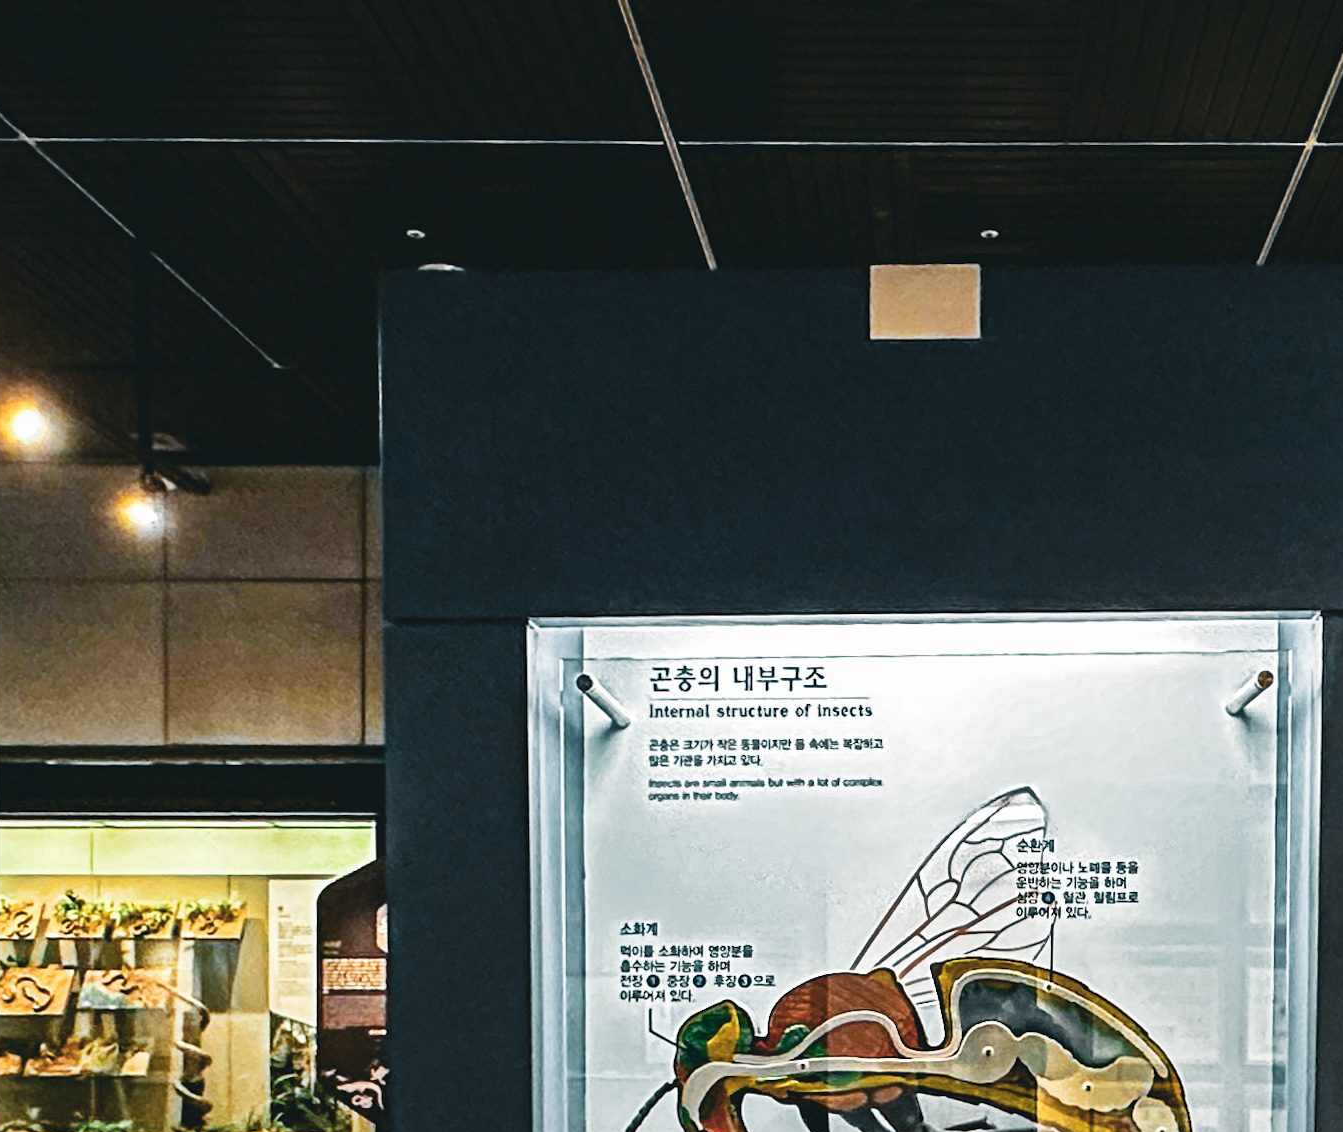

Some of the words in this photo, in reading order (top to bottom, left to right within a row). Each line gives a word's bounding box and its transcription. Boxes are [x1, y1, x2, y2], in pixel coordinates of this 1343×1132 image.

[649, 665, 719, 692] 곤충의
[733, 665, 827, 692] 내부구조
[649, 703, 710, 718] Internal
[716, 704, 788, 718] structure
[795, 703, 811, 717] of
[817, 703, 873, 717] insects
[649, 738, 680, 751] 곤충은
[683, 739, 713, 751] 크기가
[717, 739, 737, 750] 작은
[740, 738, 791, 751] 동물이지만
[809, 738, 839, 750] 속에는
[843, 738, 883, 750] 복잡하고
[649, 755, 670, 767] 많은
[673, 755, 703, 767] 기관을
[706, 755, 737, 766] 가지고
[702, 778, 727, 788] small
[768, 777, 783, 787] but
[808, 779, 815, 787] a
[817, 778, 829, 787] lot
[831, 777, 840, 787] of
[682, 792, 691, 800] in
[1016, 838, 1054, 853] 순환계
[1016, 861, 1074, 874] 영양분이나
[1016, 876, 1061, 889] 운반하는
[1066, 876, 1099, 889] 기능을
[1104, 876, 1127, 889] 하며
[620, 922, 658, 936] 소화계
[620, 945, 654, 957] 먹이를
[658, 945, 703, 957] 소화하여
[708, 945, 753, 958] 영양분을
[620, 960, 665, 972] 흡수하는
[670, 960, 704, 972] 기능을
[708, 960, 730, 972] 하며
[620, 990, 665, 1002] 이루어져
